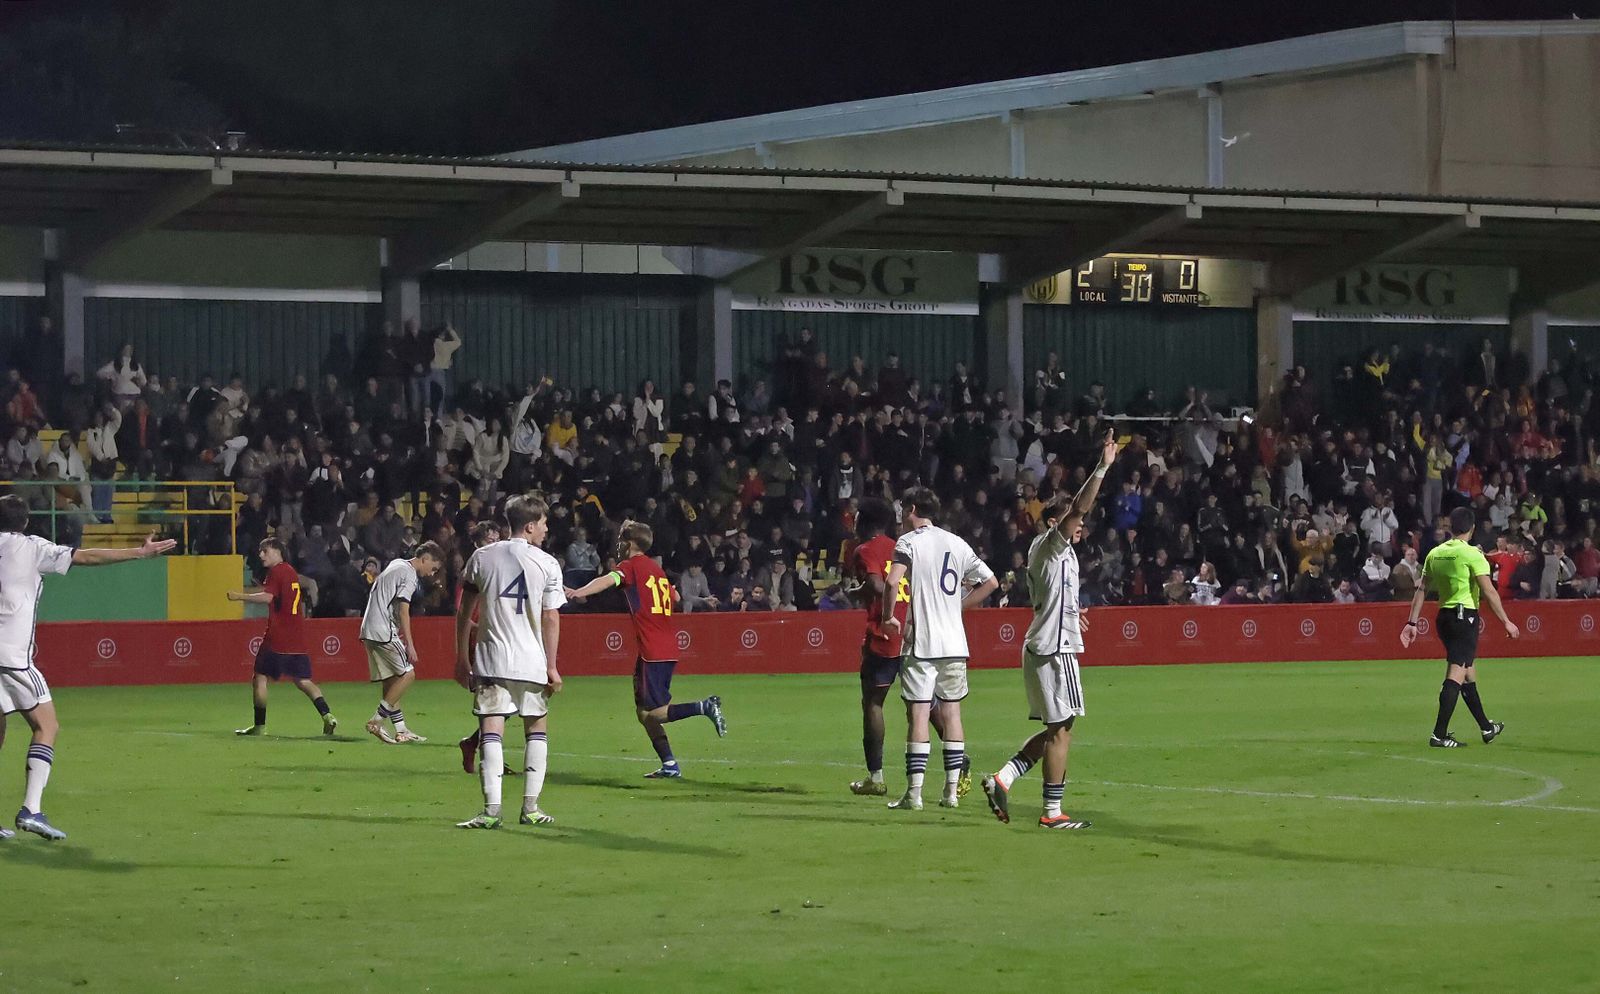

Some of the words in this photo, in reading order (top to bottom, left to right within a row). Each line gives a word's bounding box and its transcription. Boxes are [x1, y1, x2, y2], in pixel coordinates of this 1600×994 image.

[777, 254, 919, 296] RSG
[1077, 260, 1094, 287] 2
[1128, 263, 1147, 271] TIEMPO
[1180, 261, 1195, 289] 0
[1080, 291, 1106, 302] LOCAL
[1121, 273, 1152, 301] 30
[1162, 293, 1198, 304] VISITANTE
[940, 551, 958, 596] 6
[291, 582, 301, 615] 7
[499, 569, 528, 615] 4
[645, 574, 671, 616] 18
